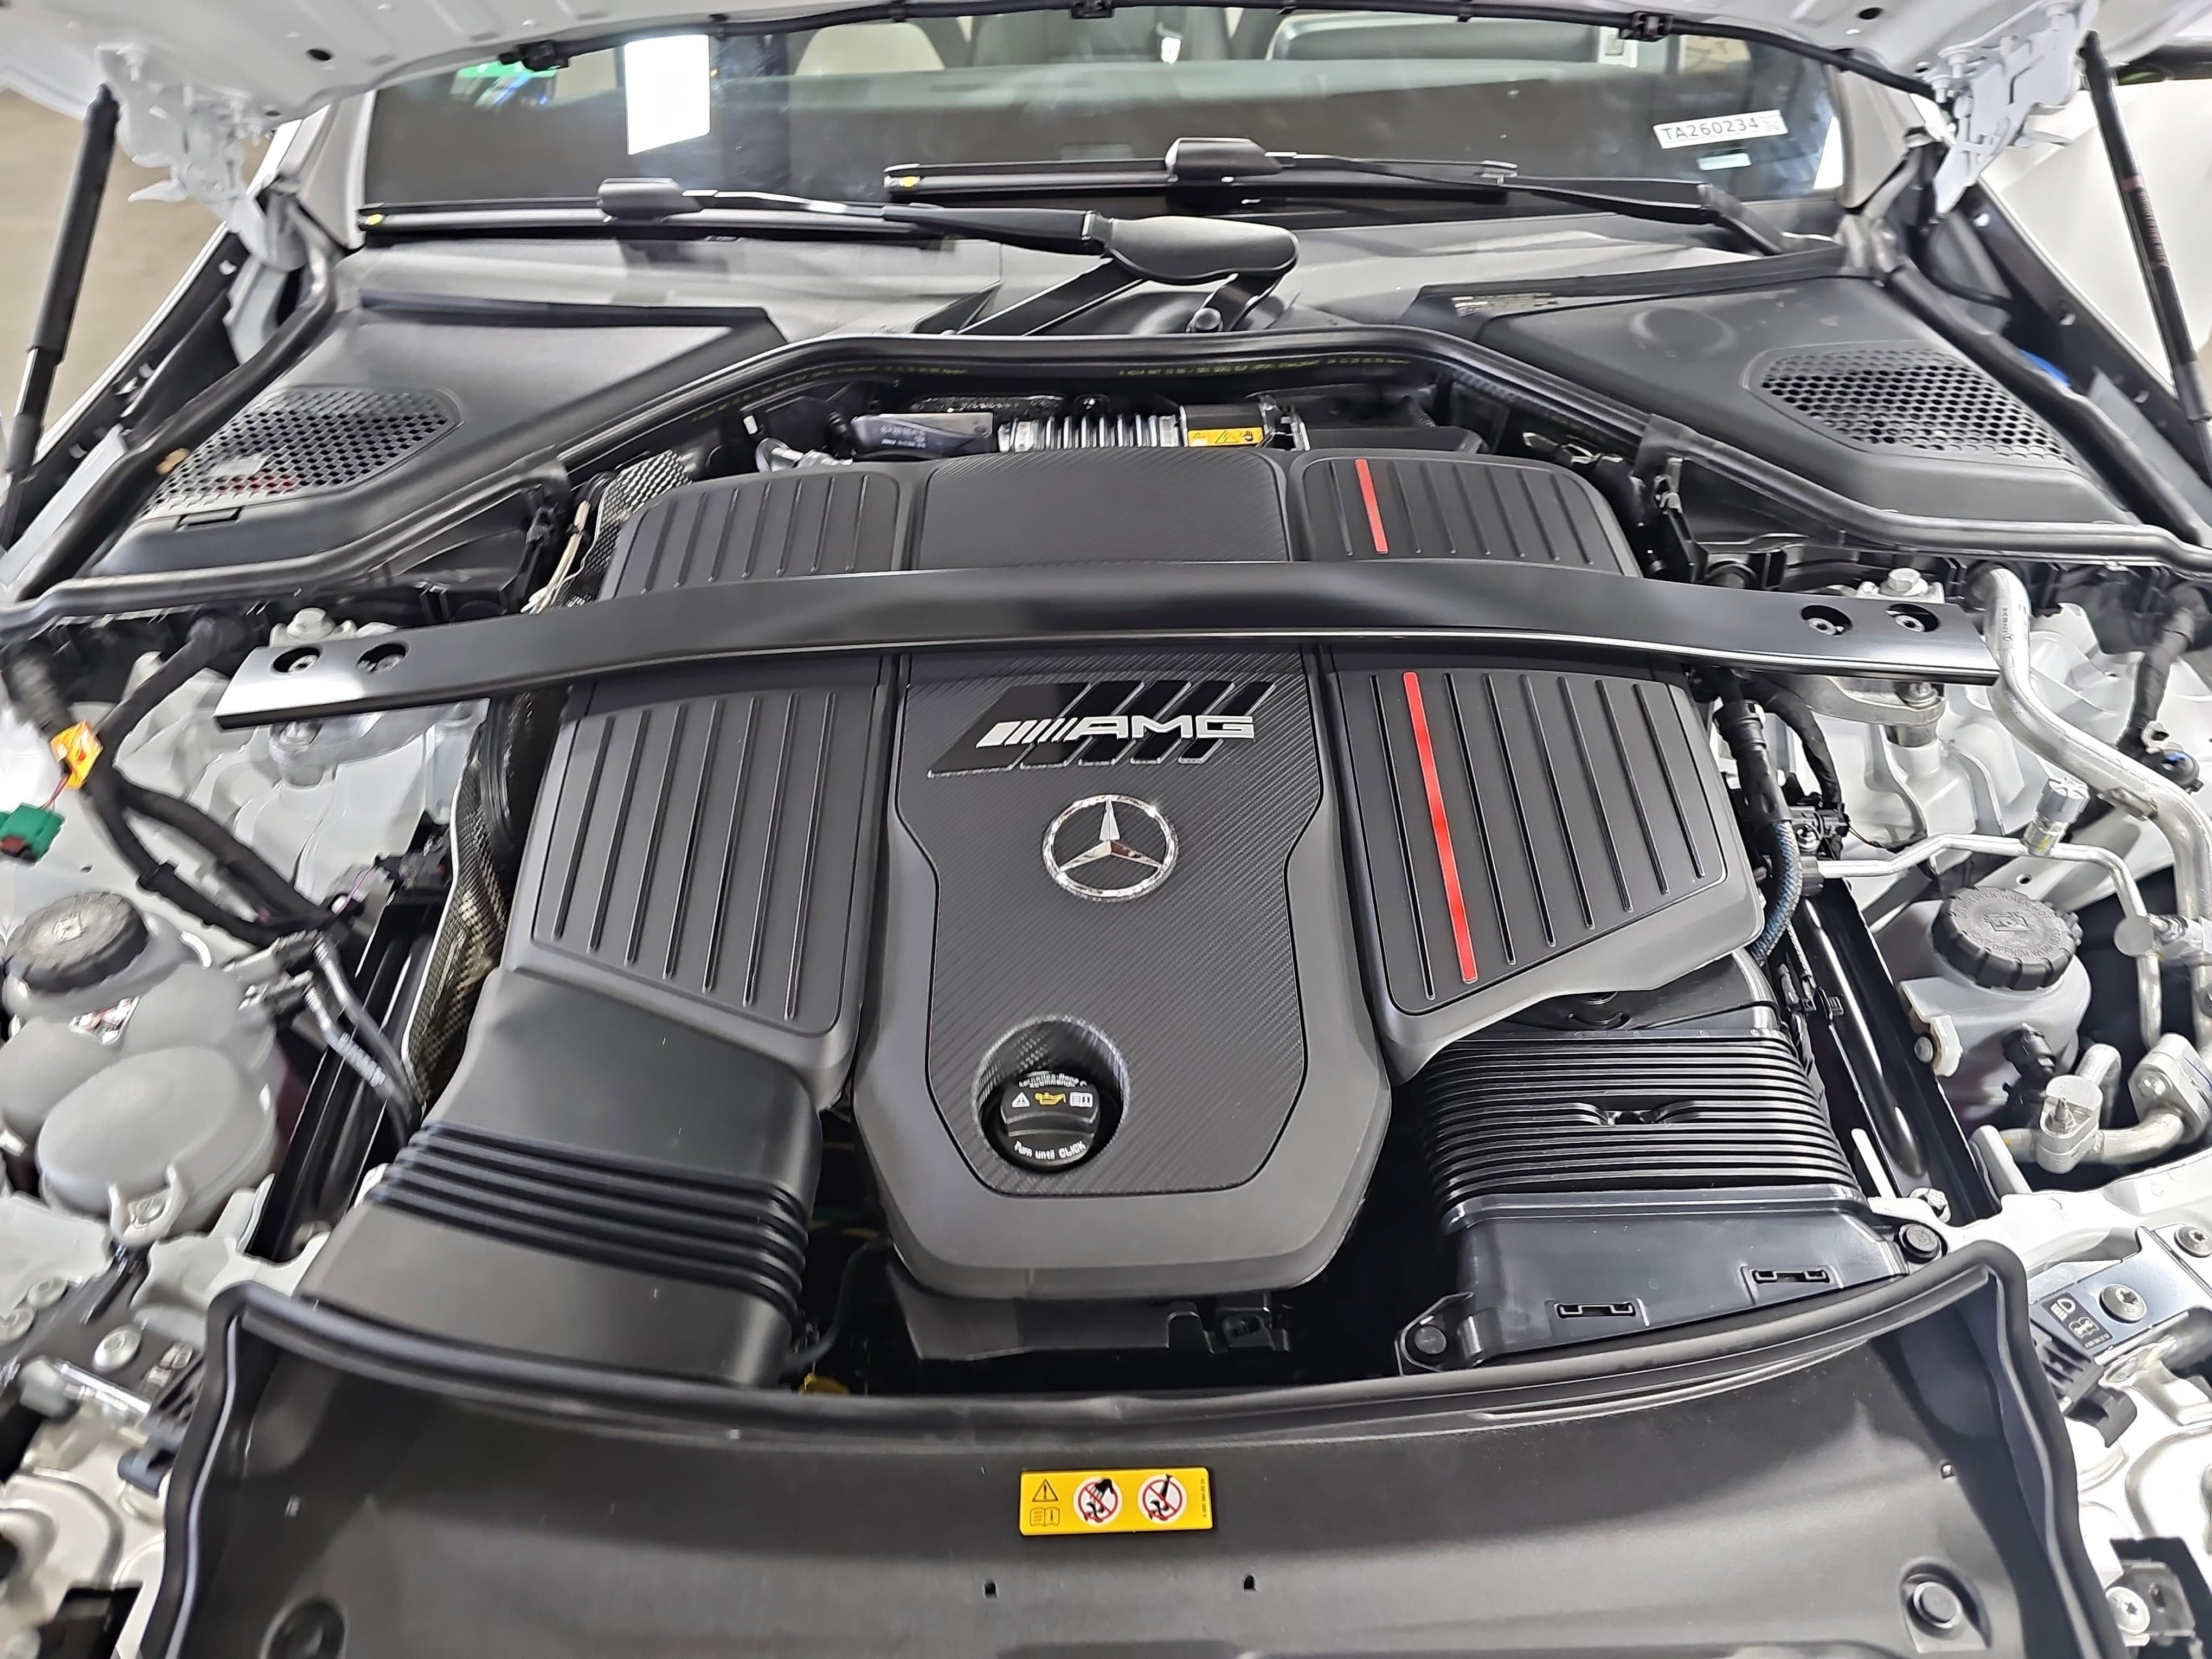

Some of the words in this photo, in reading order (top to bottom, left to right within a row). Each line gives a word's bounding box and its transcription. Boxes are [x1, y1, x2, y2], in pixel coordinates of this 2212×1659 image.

[1660, 118, 1759, 140] TA260234
[1063, 715, 1255, 741] AMG
[1014, 1140, 1033, 1158] Turn
[1034, 1149, 1056, 1160] until
[1058, 1140, 1086, 1159] CLICK
